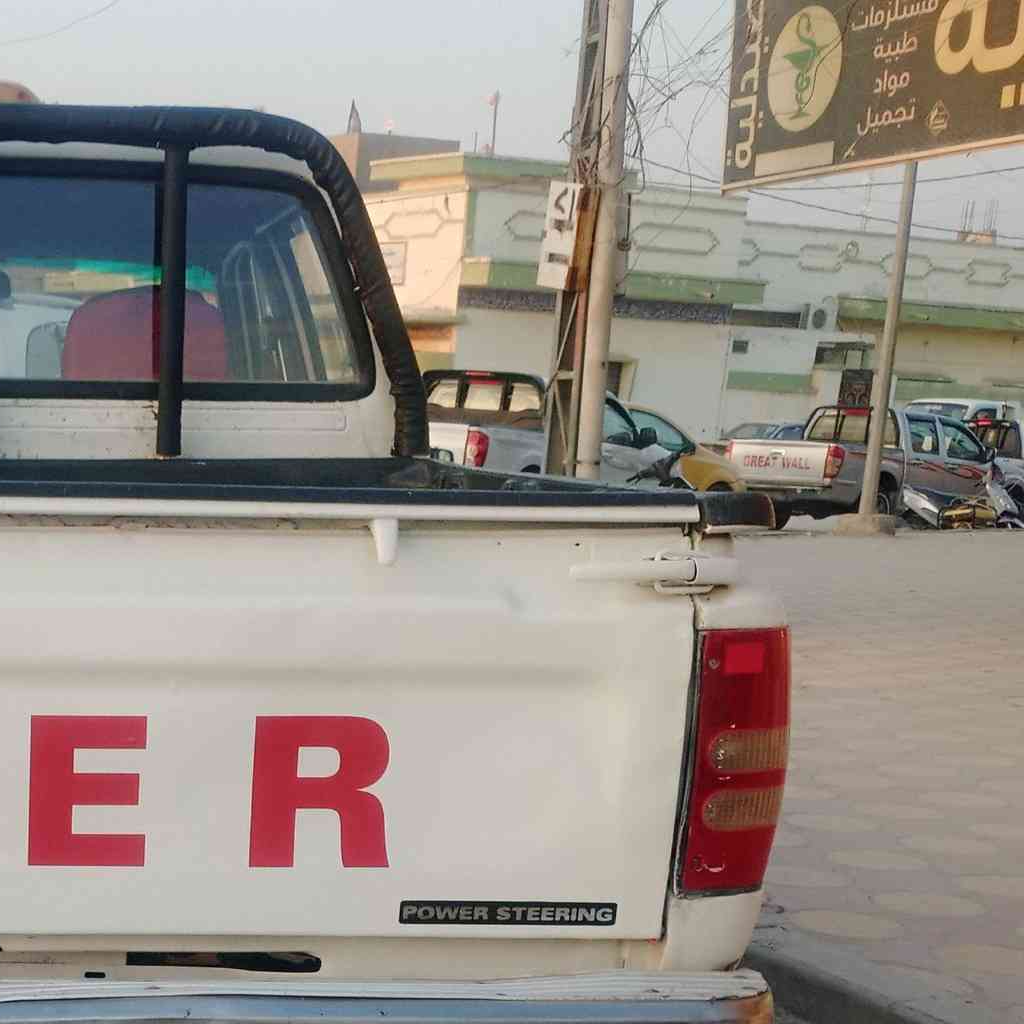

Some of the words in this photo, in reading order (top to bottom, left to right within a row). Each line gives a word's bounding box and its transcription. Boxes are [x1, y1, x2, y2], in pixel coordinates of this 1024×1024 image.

[873, 31, 919, 63] طبية
[873, 69, 911, 97] مواد
[856, 98, 916, 136] تجميل
[781, 456, 811, 470] WALL
[402, 905, 489, 921] POWER
[495, 906, 614, 922] STEERING
